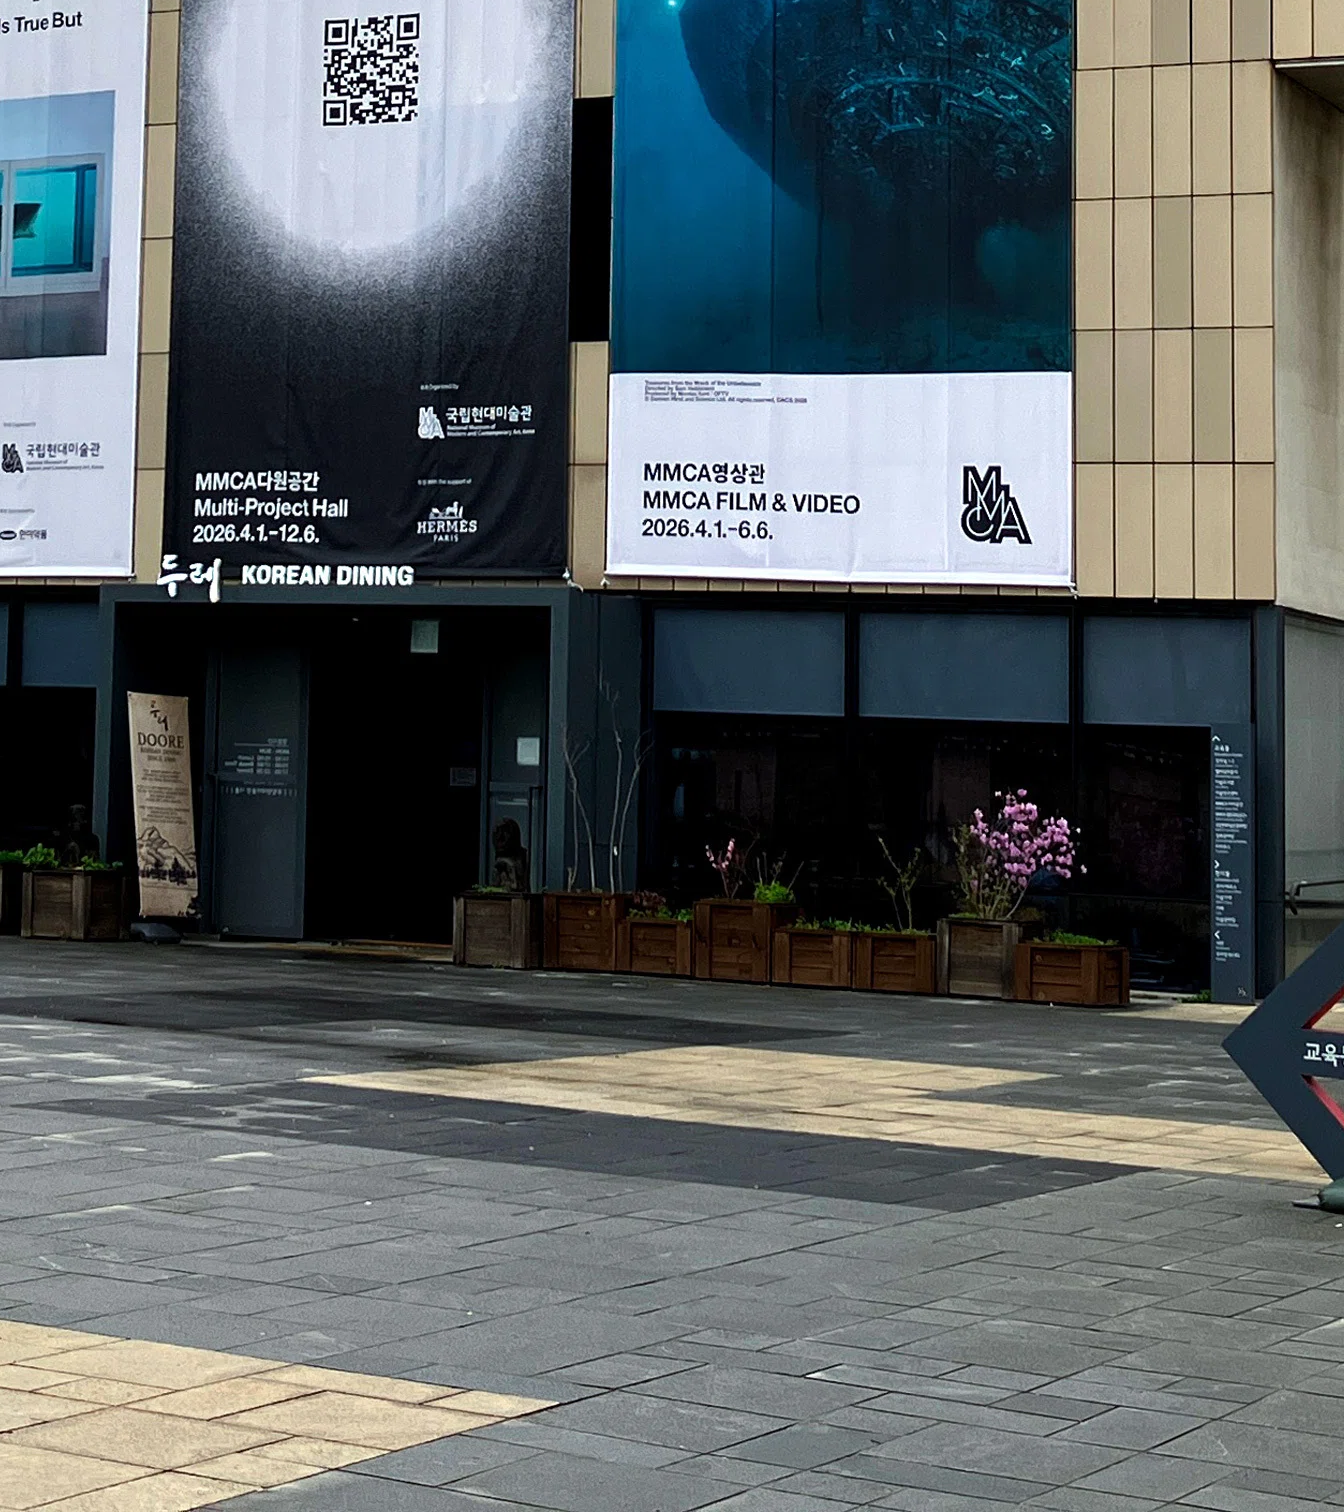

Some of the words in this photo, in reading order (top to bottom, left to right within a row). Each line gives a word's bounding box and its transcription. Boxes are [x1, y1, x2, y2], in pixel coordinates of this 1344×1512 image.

[14, 15, 49, 33] True
[52, 11, 83, 30] But
[446, 405, 532, 423] 국립현대미술관
[195, 471, 320, 492] MMCA다원공간
[643, 462, 765, 485] MMCA영상관
[194, 498, 309, 519] Multi-Project
[313, 499, 348, 518] Hall
[643, 491, 711, 510] MMCA
[716, 494, 766, 513] FILM
[772, 494, 787, 513] &
[792, 495, 861, 514] VIDEO
[960, 465, 1032, 545] MMCA
[433, 534, 459, 542] PARIS
[242, 565, 331, 586] KOREAN
[336, 565, 414, 586] DINING
[137, 732, 184, 749] DOORE
